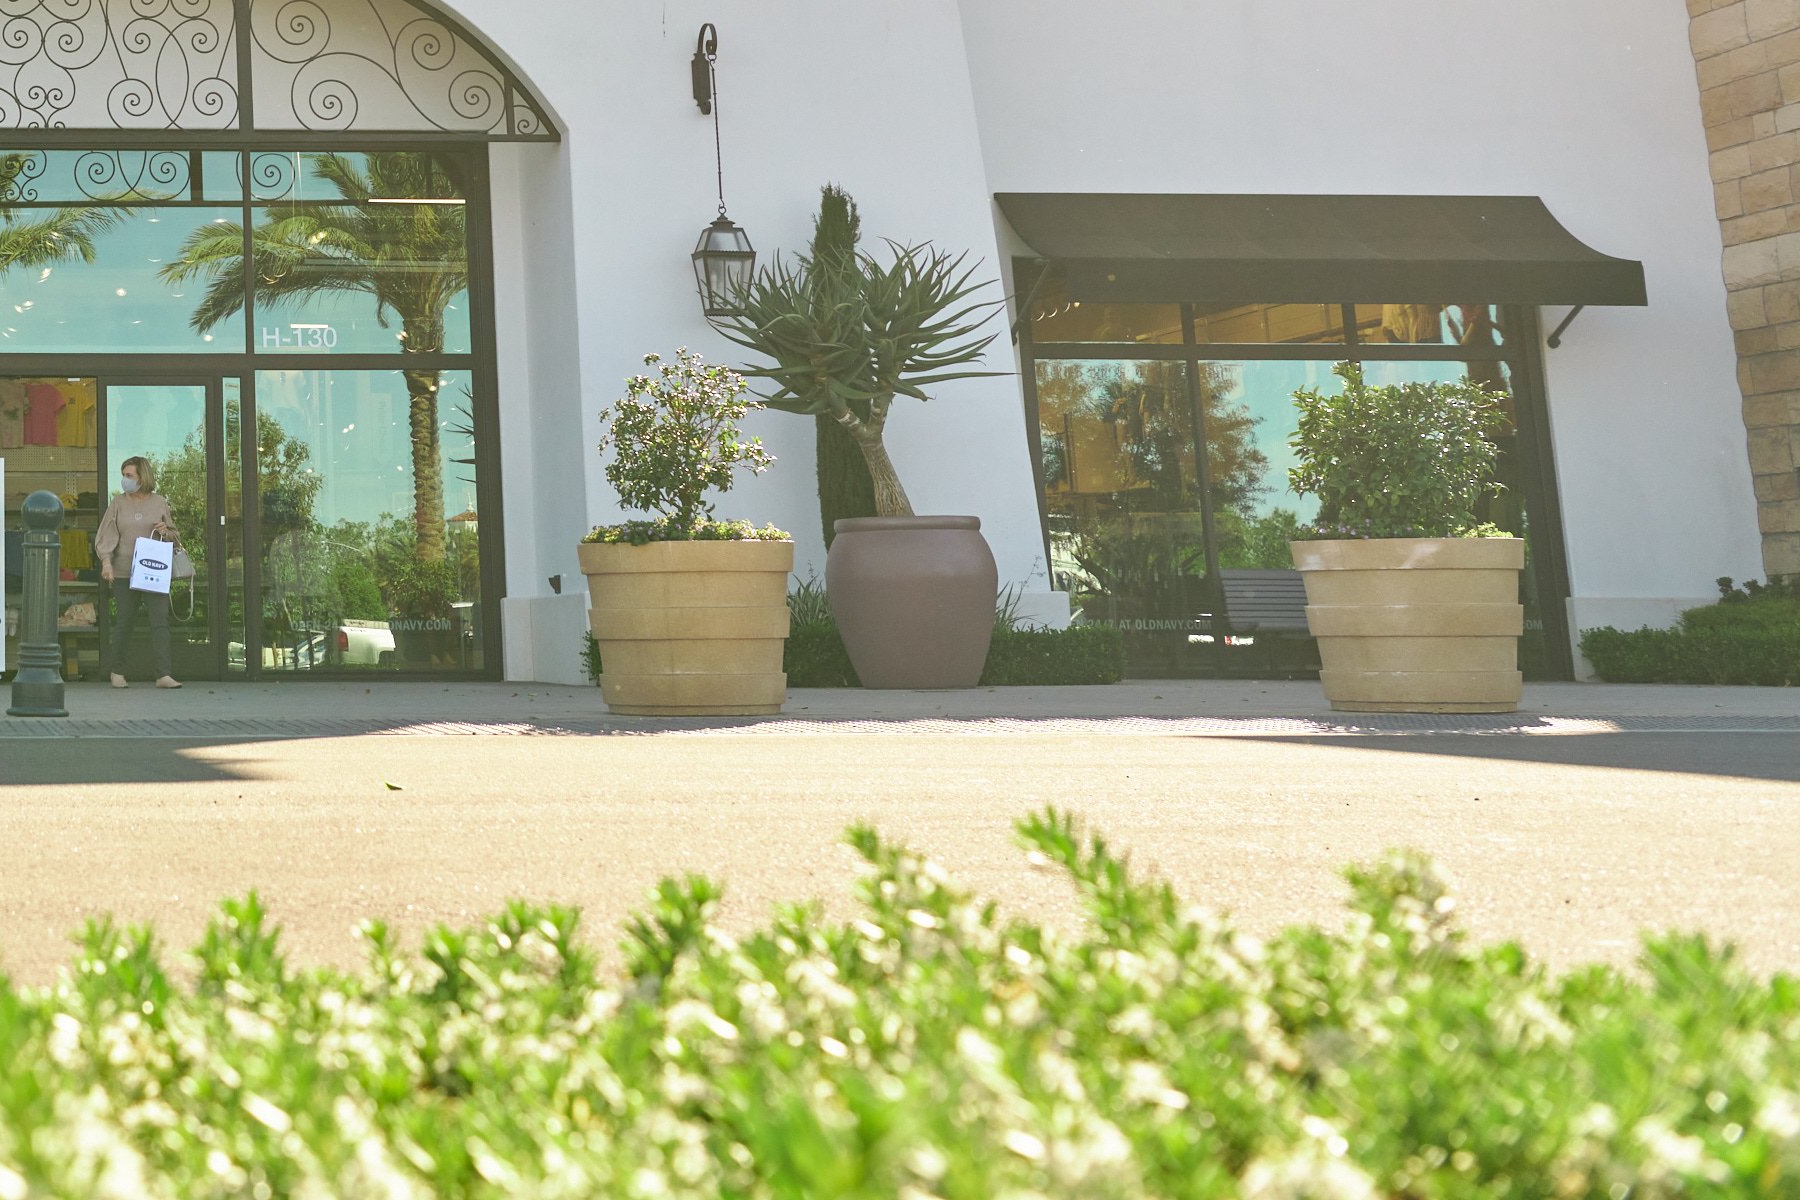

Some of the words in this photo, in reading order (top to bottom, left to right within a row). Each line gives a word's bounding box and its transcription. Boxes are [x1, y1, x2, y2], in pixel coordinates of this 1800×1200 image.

[262, 327, 338, 349] H-130
[1118, 618, 1132, 630] AT
[1135, 619, 1213, 630] OLDNAVY.COM
